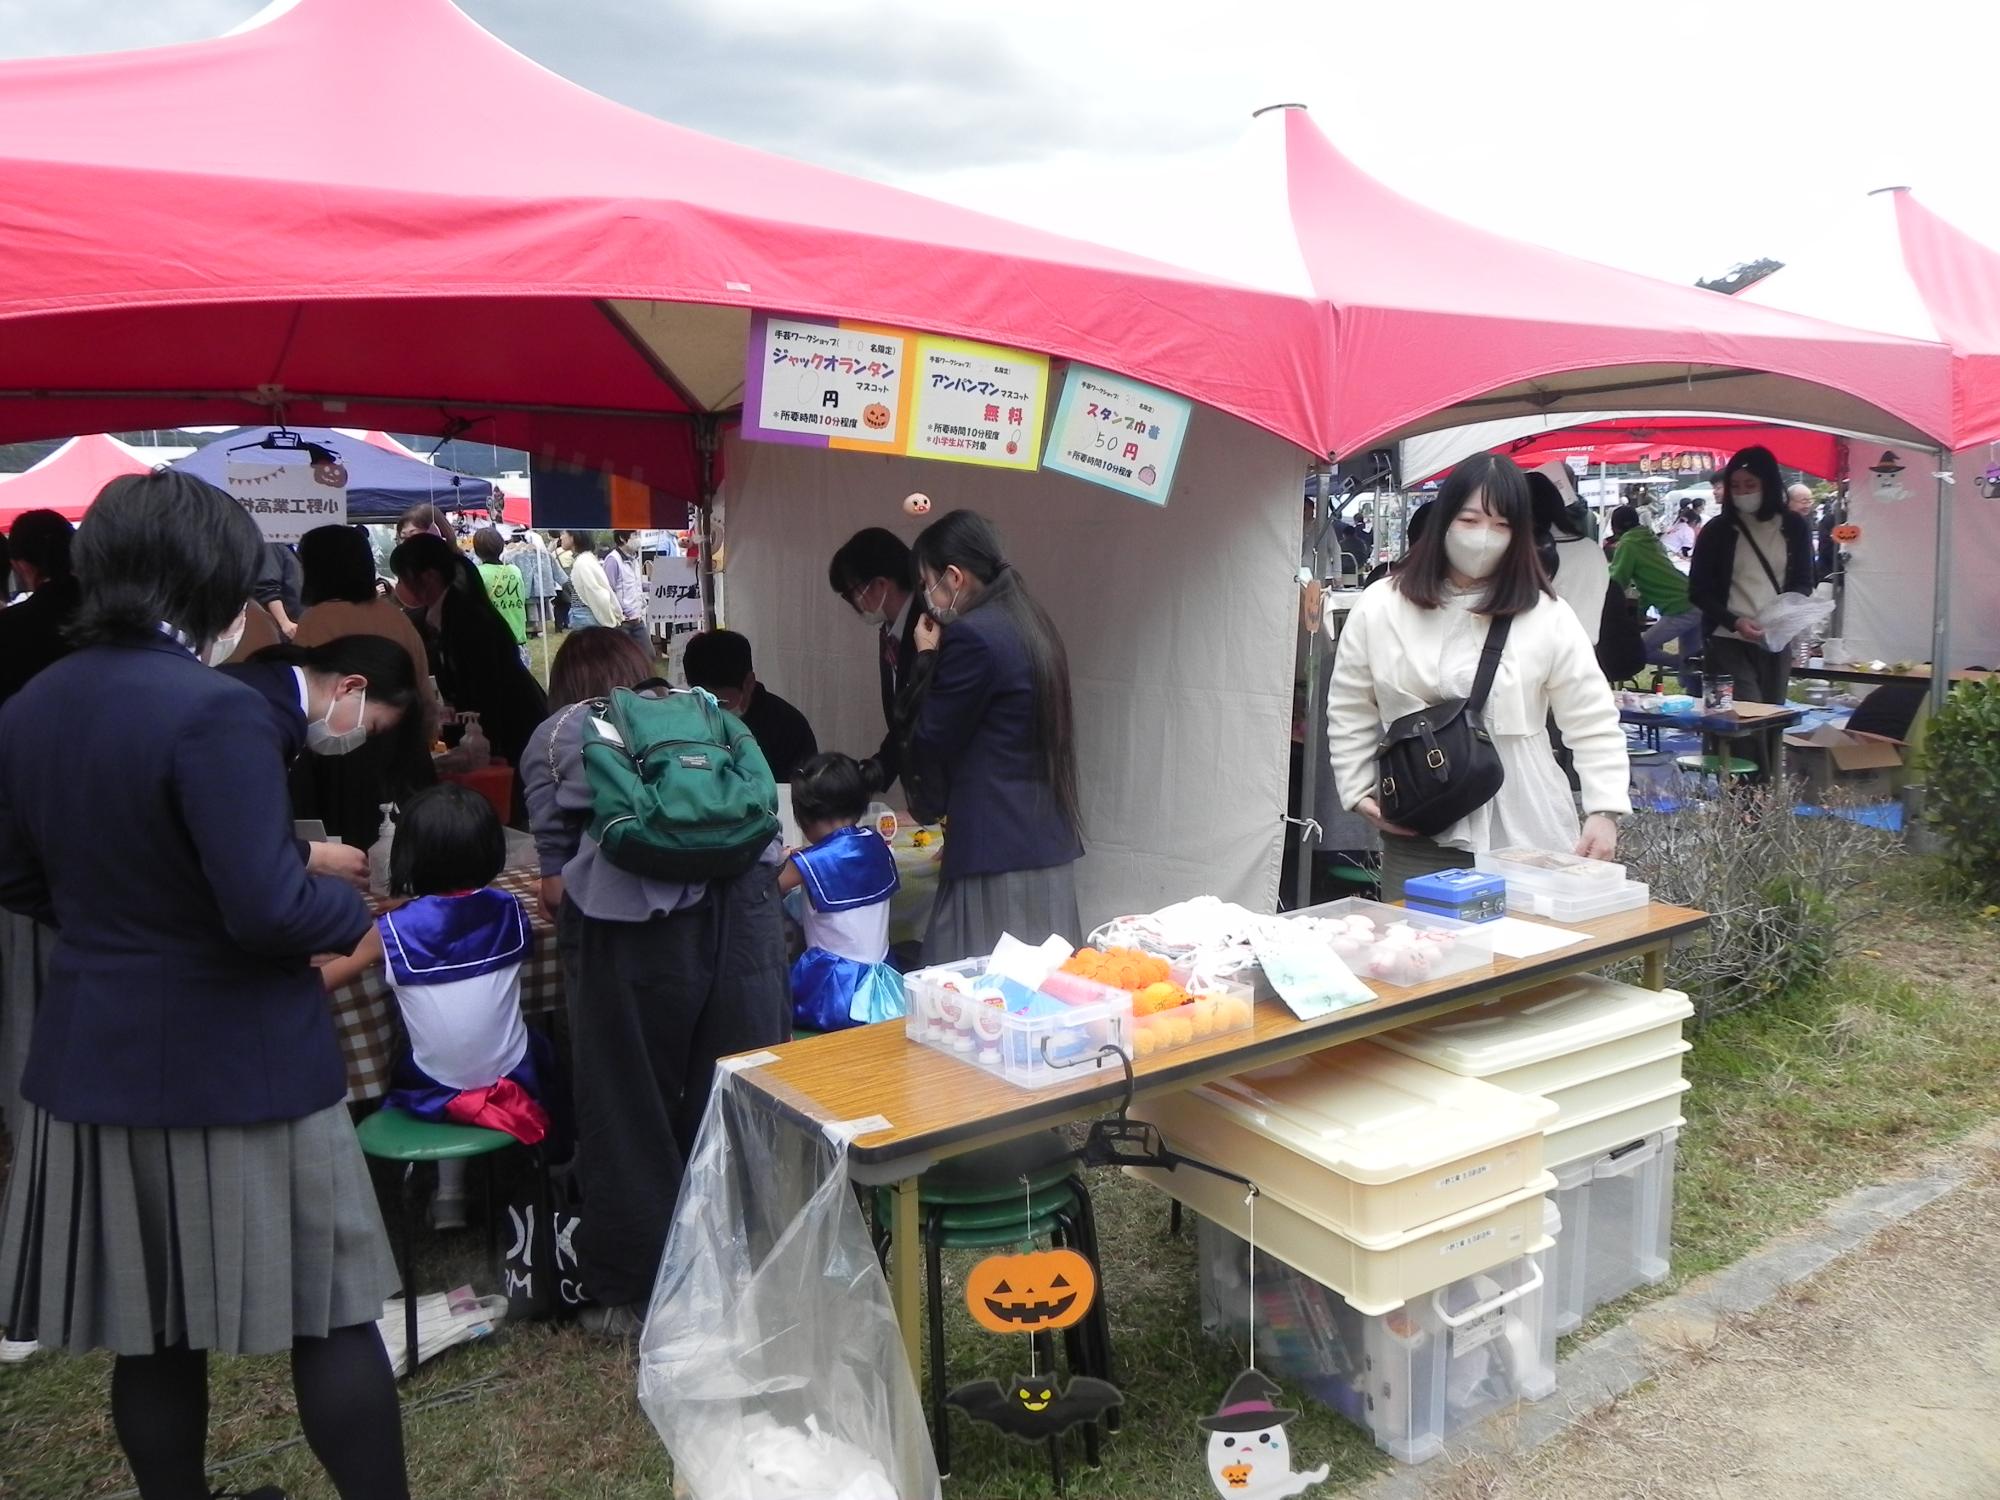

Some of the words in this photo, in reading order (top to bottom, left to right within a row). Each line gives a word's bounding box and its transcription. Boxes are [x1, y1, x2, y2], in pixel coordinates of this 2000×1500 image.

[772, 347, 895, 379] ジャックオランタン
[822, 390, 839, 408] 円
[855, 381, 889, 394] マスコット
[931, 374, 1000, 396] アンパンマン
[1000, 389, 1029, 400] マスコット
[1095, 431, 1118, 451] 50
[1122, 442, 1139, 461] 円
